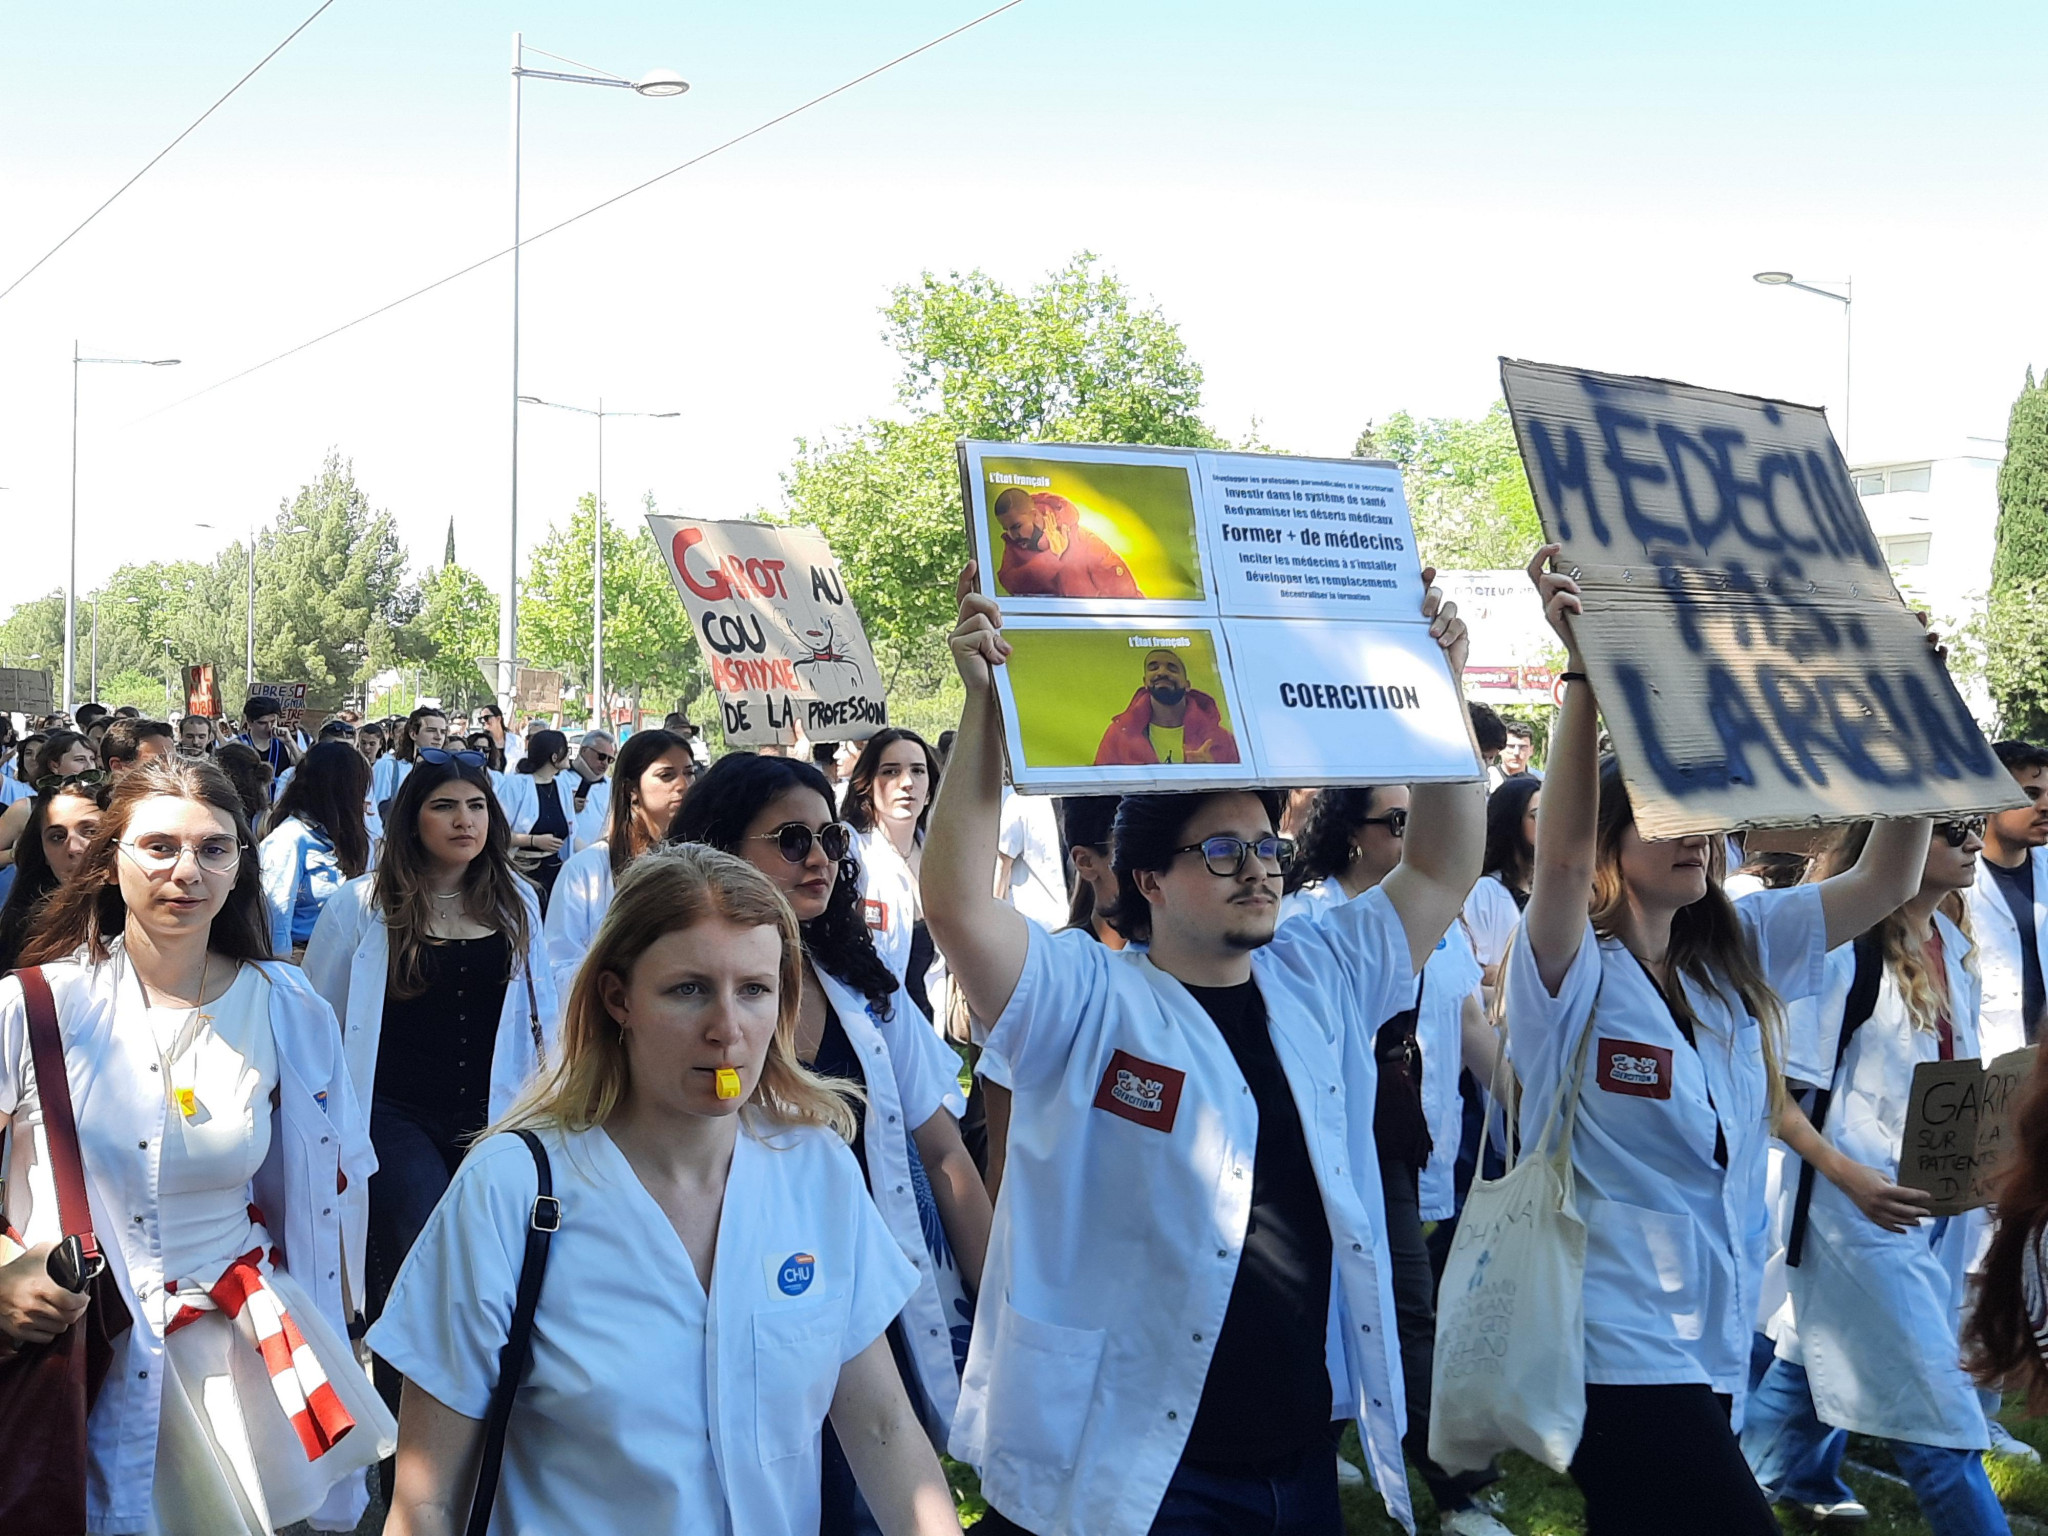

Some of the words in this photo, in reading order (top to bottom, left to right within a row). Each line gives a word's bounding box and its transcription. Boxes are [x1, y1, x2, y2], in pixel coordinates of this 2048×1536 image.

[1225, 487, 1264, 499] Investir
[1266, 489, 1291, 501] dans
[1293, 490, 1302, 501] le
[1305, 492, 1345, 504] système
[1347, 494, 1358, 505] de
[1360, 497, 1386, 507] santé
[1224, 504, 1290, 517] Redynamiser
[1293, 507, 1308, 518] les
[1310, 508, 1346, 521] déserts
[1348, 511, 1393, 525] médicaux
[1222, 523, 1282, 543] Former
[1286, 530, 1296, 541] +
[1300, 528, 1321, 546] de
[1325, 530, 1404, 551] médecins
[672, 527, 788, 602] GAROT
[810, 565, 844, 606] AU
[1239, 552, 1272, 564] Inciter
[1274, 554, 1290, 566] les
[1292, 555, 1340, 568] médecins
[1342, 558, 1348, 569] à
[1350, 558, 1397, 571] s'installer
[1246, 571, 1302, 585] Développer
[1305, 574, 1320, 584] les
[1322, 576, 1398, 589] remplacements
[702, 611, 766, 654] COU
[711, 655, 800, 693] ASPHYXIE
[251, 685, 297, 697] LIBRES
[1280, 682, 1420, 709] COERCITION
[724, 701, 751, 734] DE
[766, 694, 794, 729] LA
[808, 696, 887, 729] PROFESSION
[1918, 1129, 1956, 1149] SUR
[784, 1266, 810, 1283] CHU
